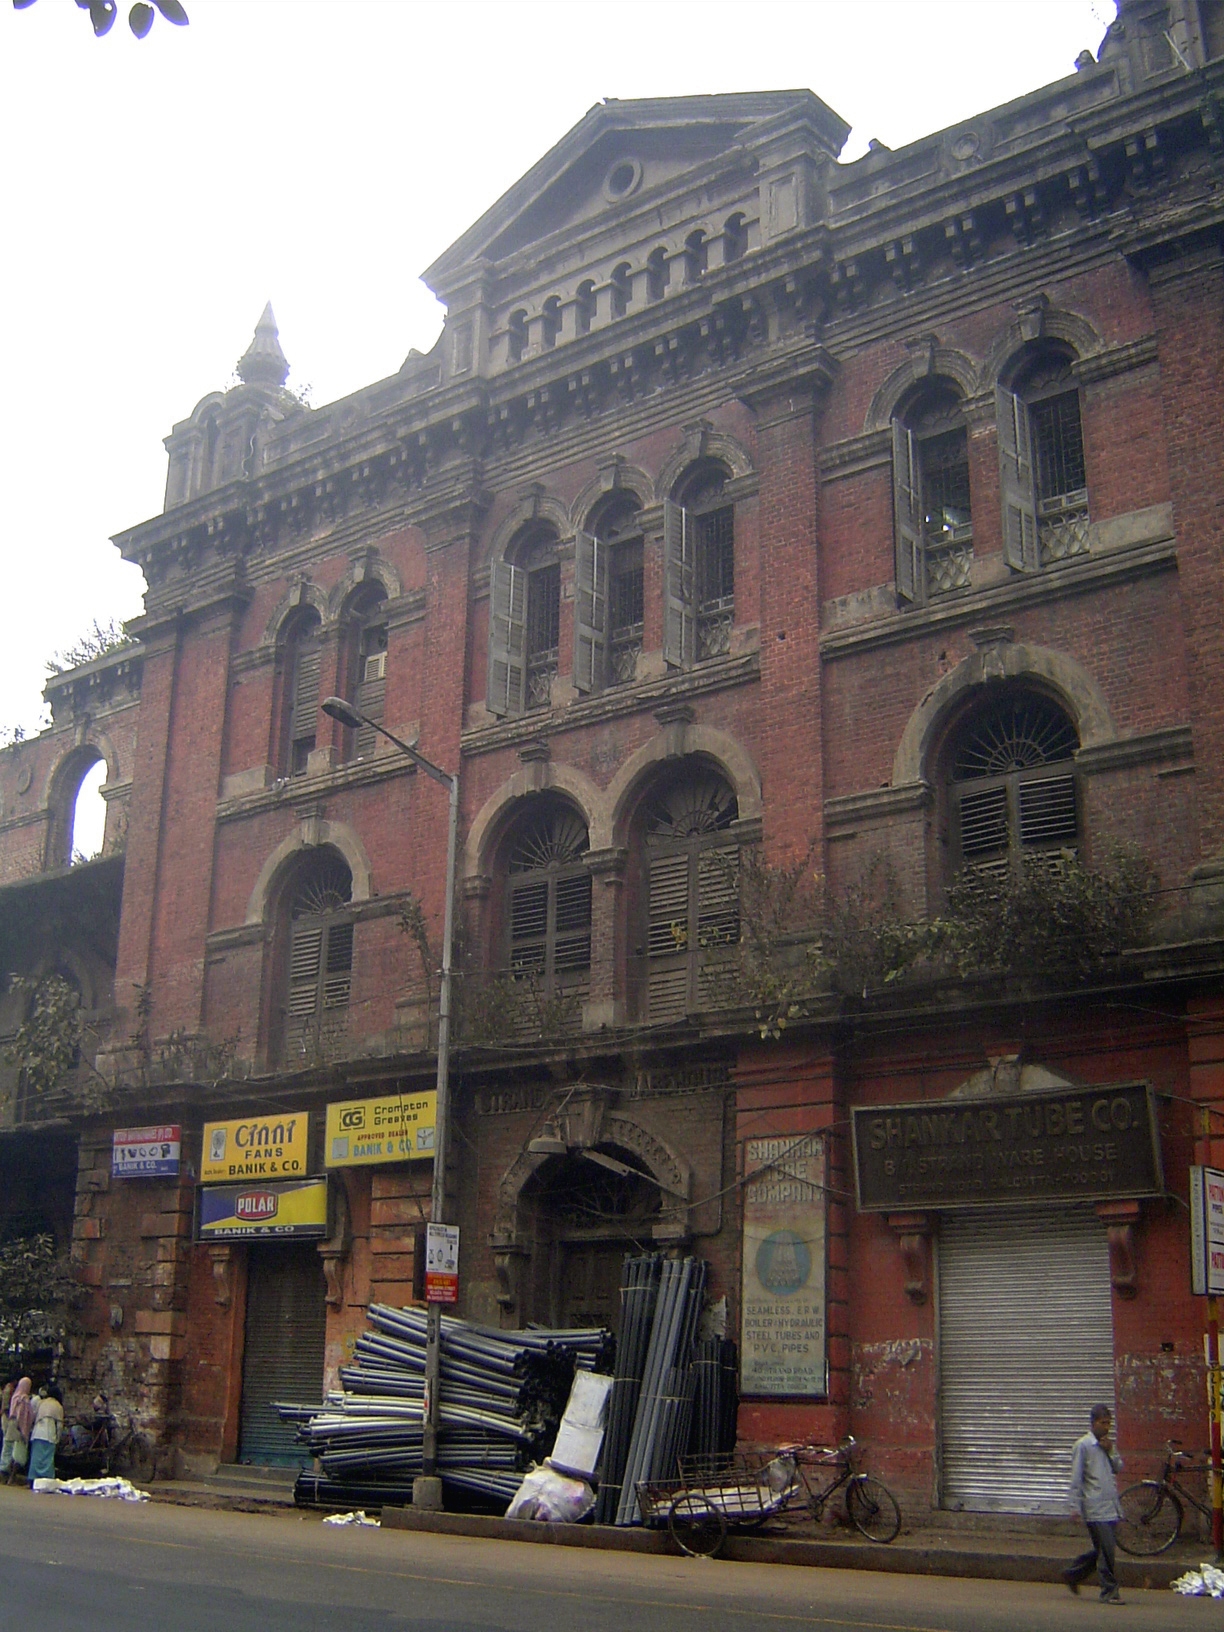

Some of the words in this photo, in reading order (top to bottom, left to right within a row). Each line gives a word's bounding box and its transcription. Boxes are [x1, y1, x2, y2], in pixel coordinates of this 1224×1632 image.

[374, 1101, 429, 1115] Crompton
[374, 1113, 418, 1126] Greaves
[869, 1110, 1003, 1150] SHANKAR
[1005, 1101, 1085, 1139] TUBE
[1091, 1097, 1139, 1132] CO.
[357, 1131, 385, 1141] APPROVED
[245, 1147, 283, 1160] FANS
[353, 1142, 382, 1157] BANIK
[747, 1136, 823, 1161] SHANKAR
[228, 1162, 266, 1176] BANIK
[270, 1161, 278, 1172] &
[282, 1159, 302, 1172] CO.
[747, 1183, 824, 1203] COMPANY
[237, 1196, 274, 1213] POLAR
[214, 1227, 256, 1236] BANIK
[260, 1226, 271, 1234] &
[275, 1225, 295, 1233] CO
[744, 1318, 773, 1328] BOILER
[746, 1330, 772, 1340] STEEL
[775, 1330, 802, 1340] TUBES
[804, 1330, 820, 1340] AND
[781, 1343, 809, 1353] PIPES
